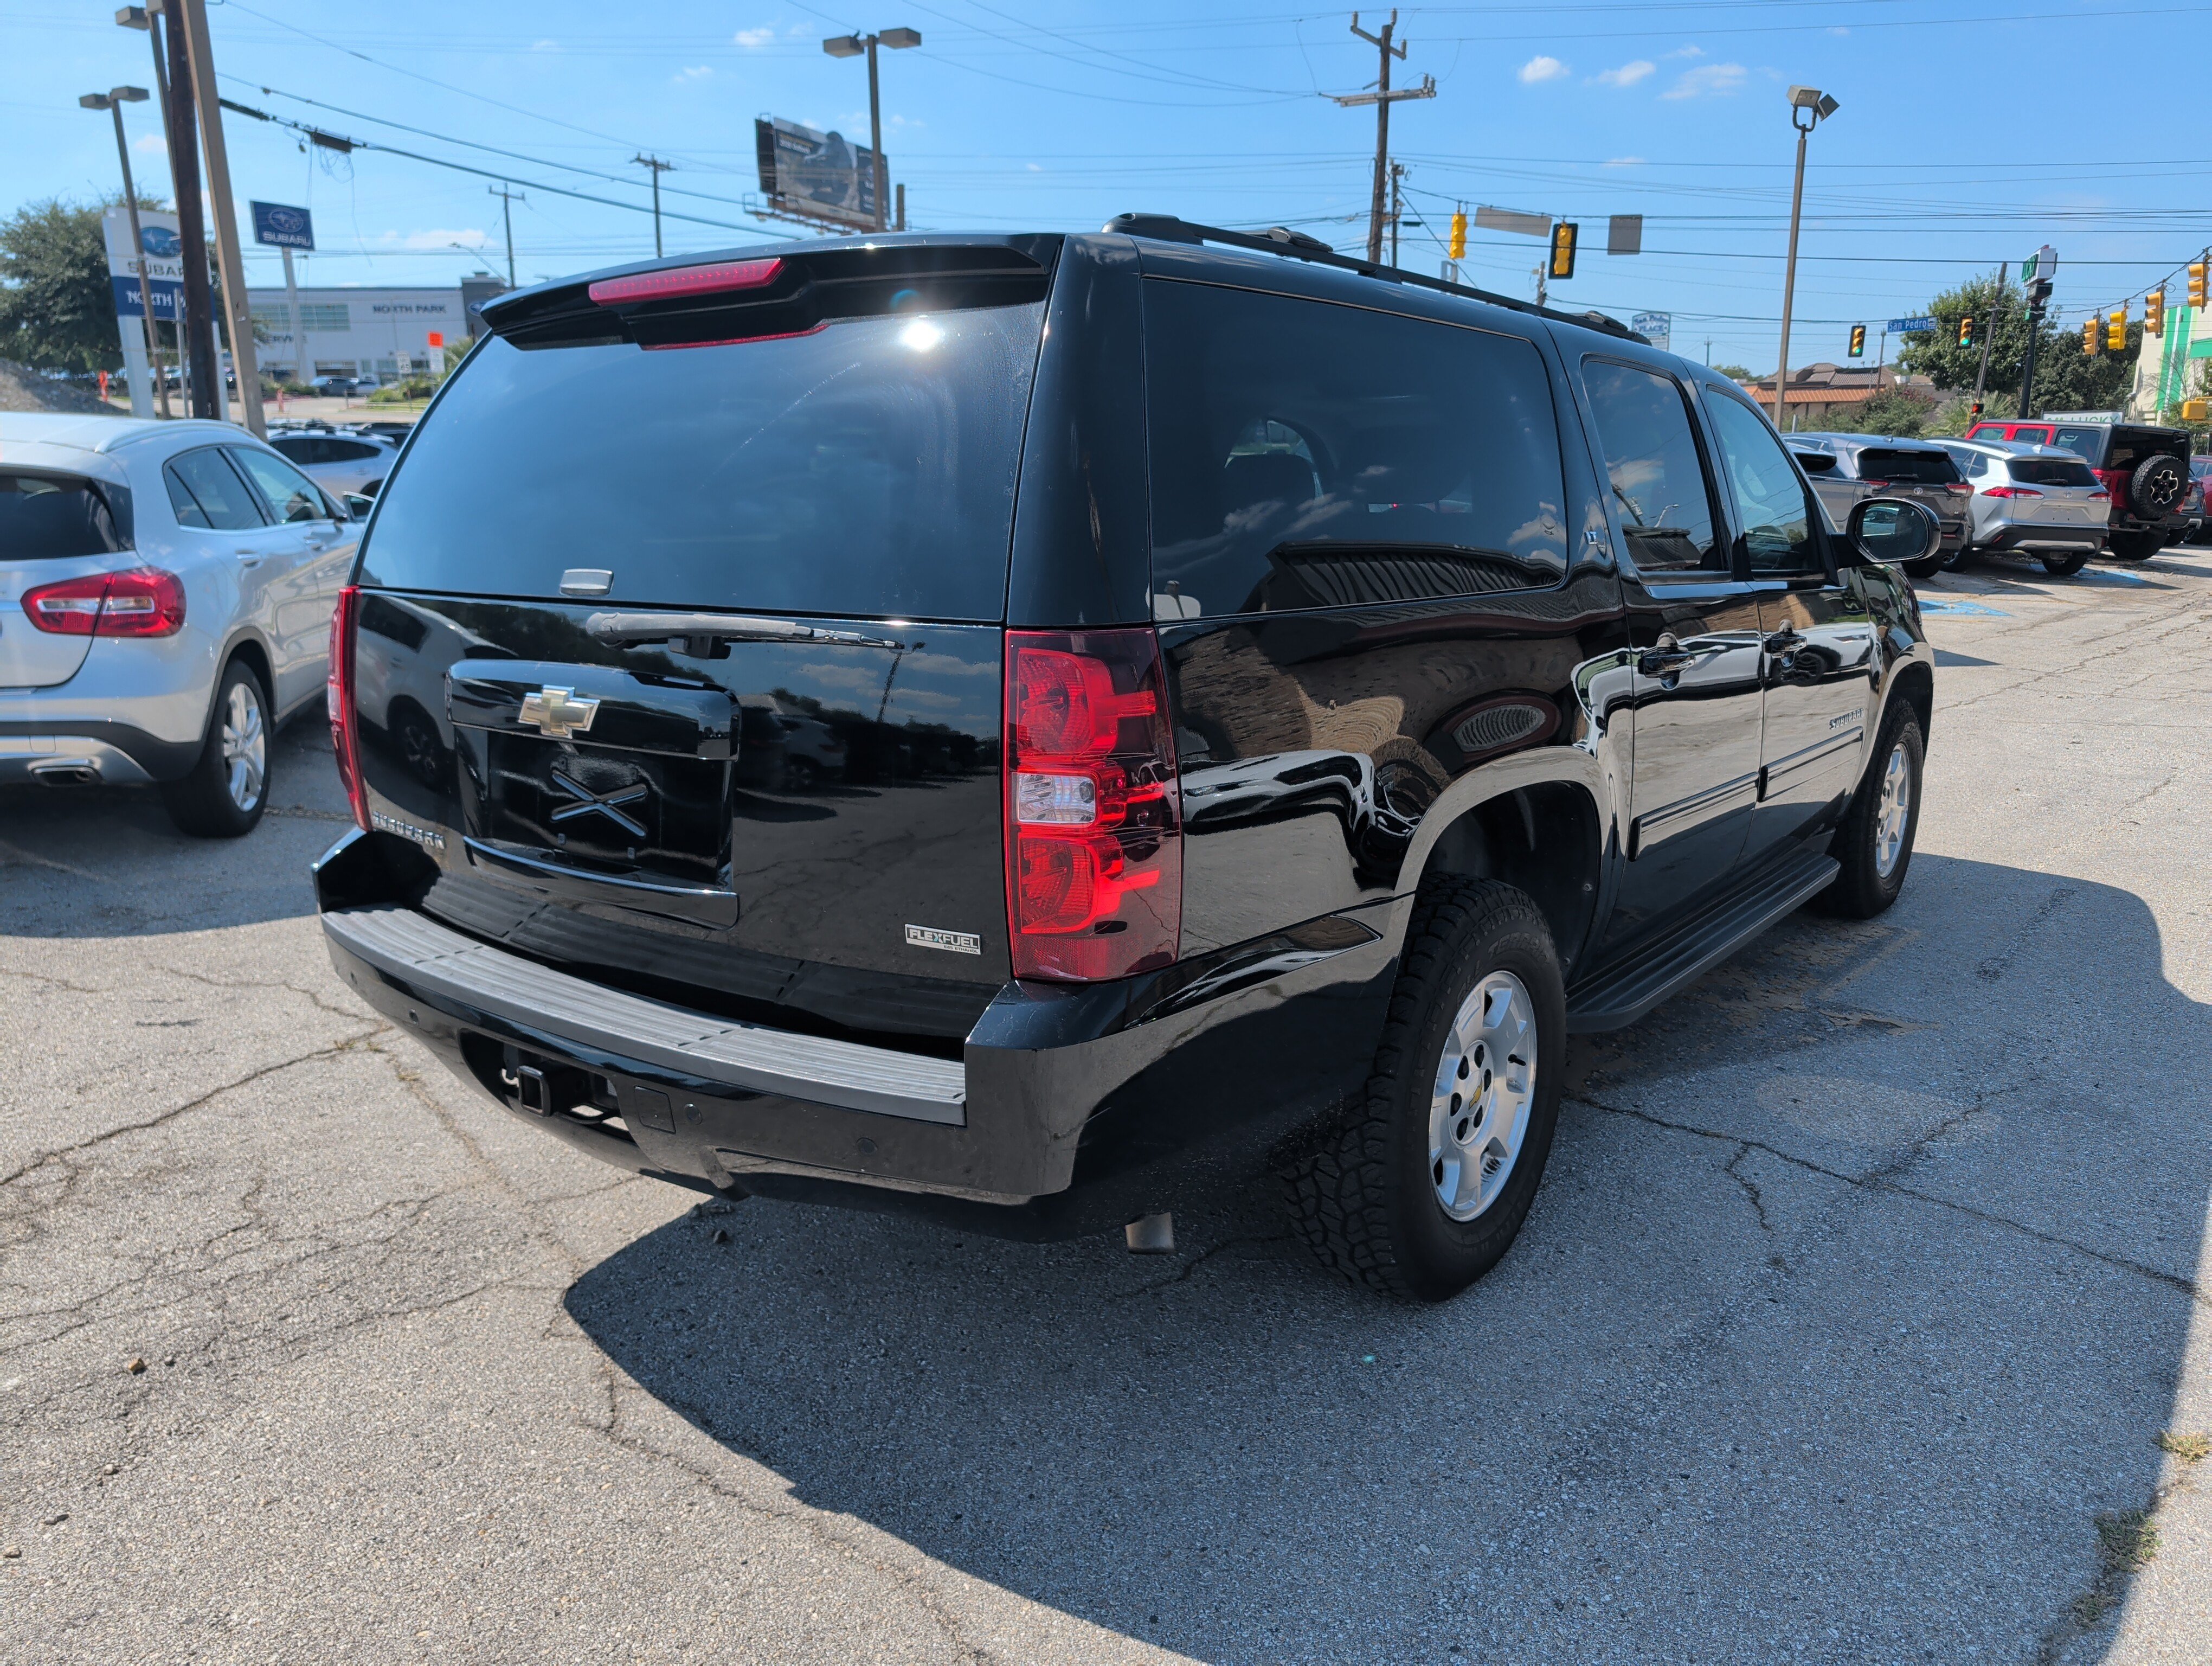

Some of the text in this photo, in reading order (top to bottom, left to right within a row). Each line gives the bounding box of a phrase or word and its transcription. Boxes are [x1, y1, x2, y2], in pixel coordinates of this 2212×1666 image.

[262, 230, 311, 247] SUBARU
[373, 305, 446, 314] NORTH PARK
[1889, 319, 1927, 330] San Pedro
[1829, 708, 1864, 730] SUBURBAN
[909, 928, 978, 948] FLEXFUEL
[954, 946, 978, 954] ETHANOL
